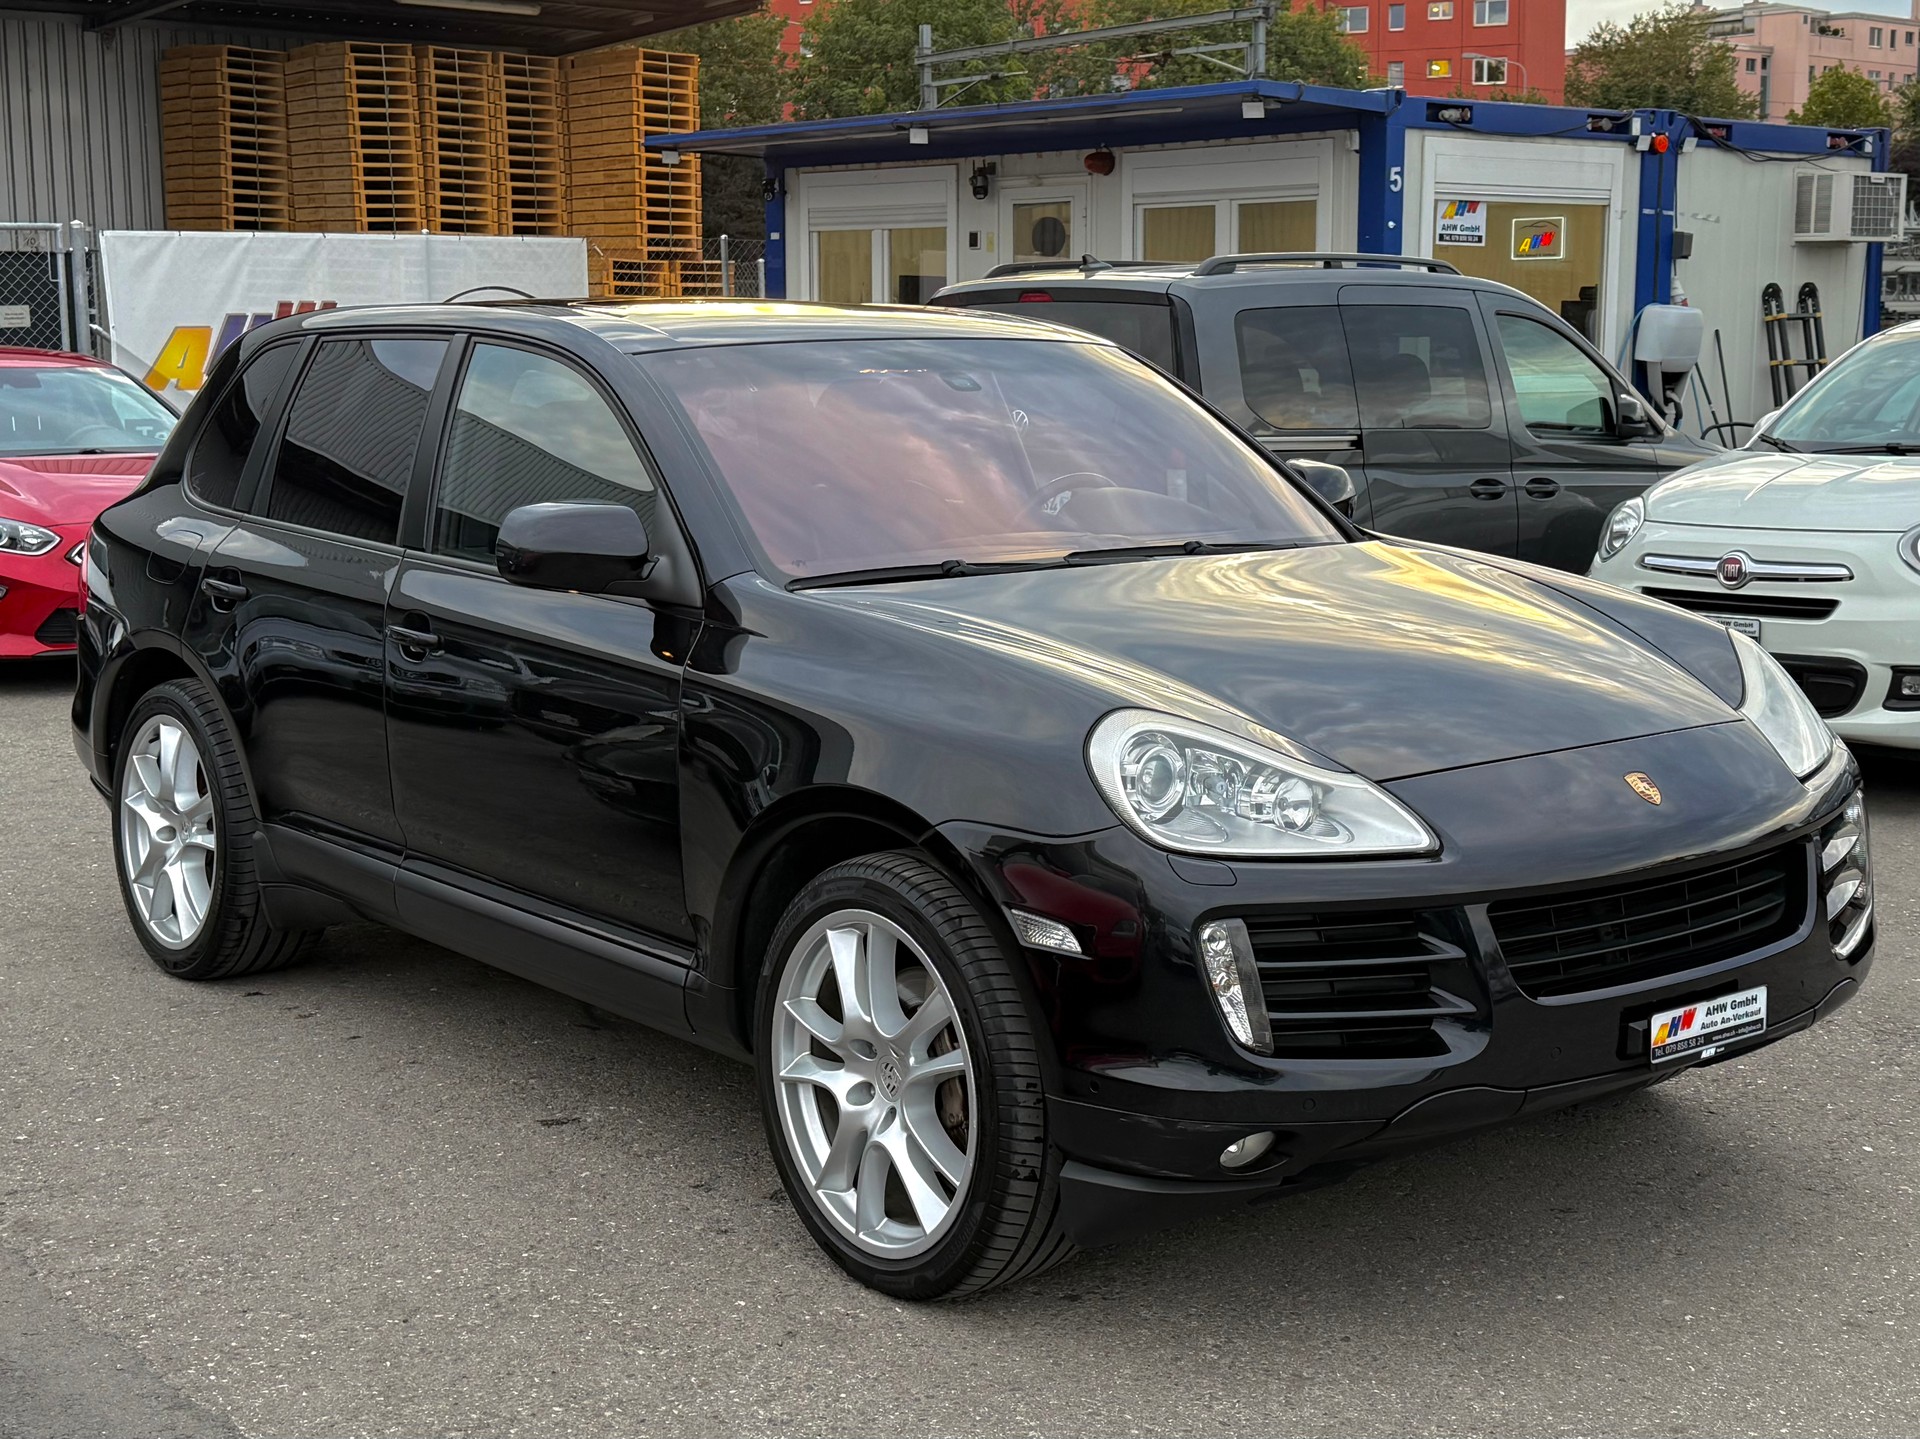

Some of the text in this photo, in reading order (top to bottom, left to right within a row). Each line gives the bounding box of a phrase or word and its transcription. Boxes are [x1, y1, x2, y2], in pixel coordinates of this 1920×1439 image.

[1389, 166, 1402, 192] 5
[1441, 223, 1481, 233] AHW GmbH
[1724, 564, 1741, 578] FIAT
[1733, 621, 1754, 629] GmbH
[1705, 994, 1758, 1017] AHW GmbH
[1653, 1007, 1698, 1046] AHW
[1700, 1007, 1762, 1030] Auto An-Verkauf
[1665, 1044, 1677, 1055] 079
[1677, 1040, 1689, 1051] 858
[1689, 1038, 1697, 1048] 58
